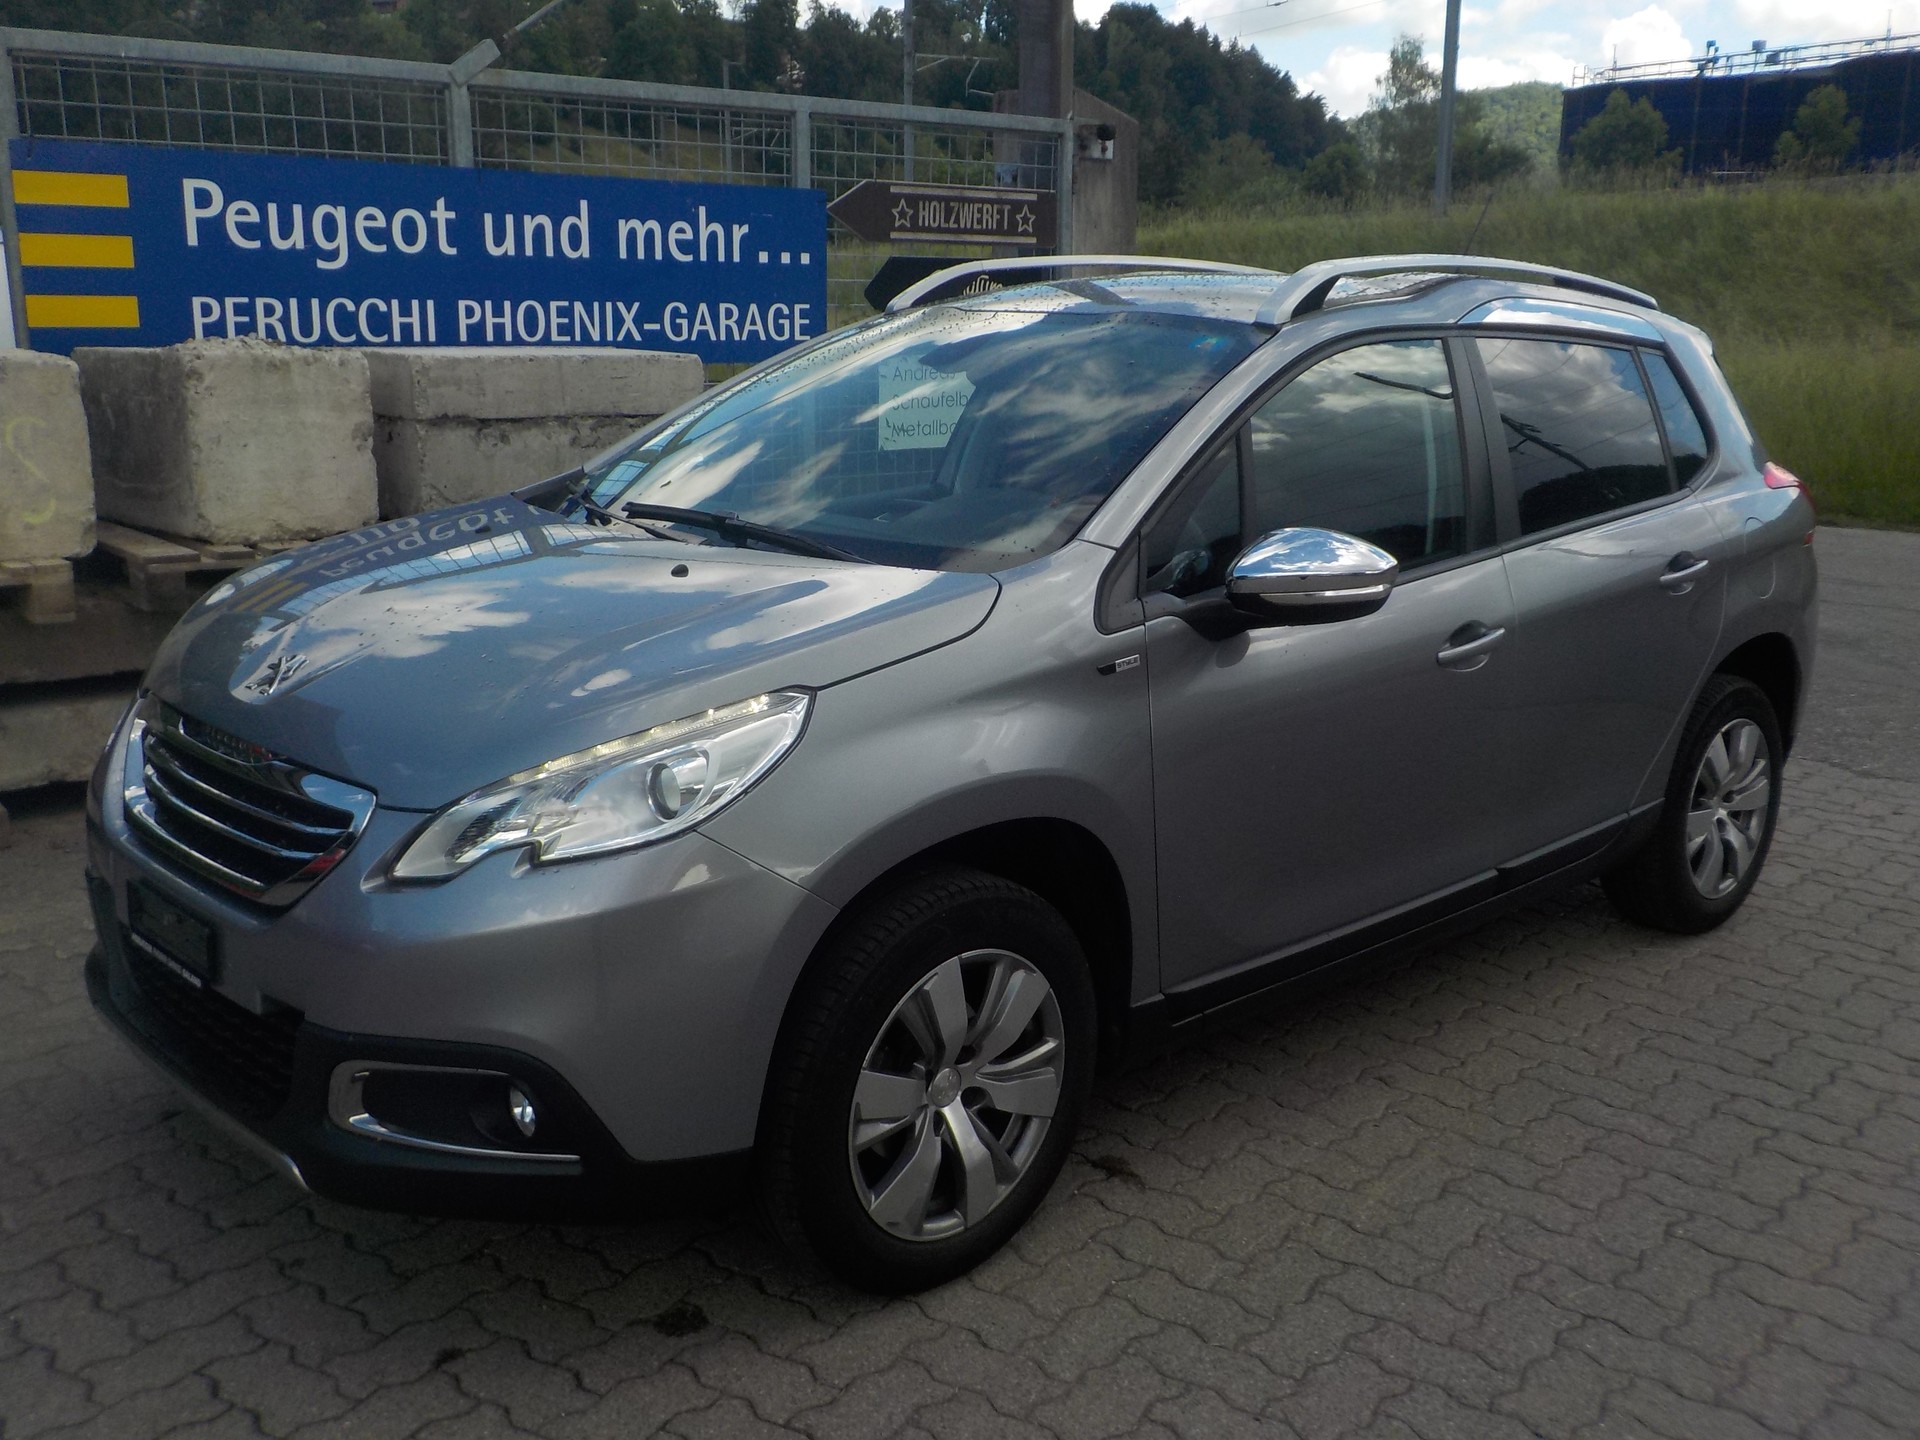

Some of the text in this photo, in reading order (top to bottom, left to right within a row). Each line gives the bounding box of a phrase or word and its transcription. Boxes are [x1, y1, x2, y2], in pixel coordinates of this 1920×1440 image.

[182, 177, 811, 271] Peugeot und mehr...
[917, 199, 1012, 231] HOLZWERFT
[191, 295, 811, 344] PERUCCHI PHOENIX-GARAGE
